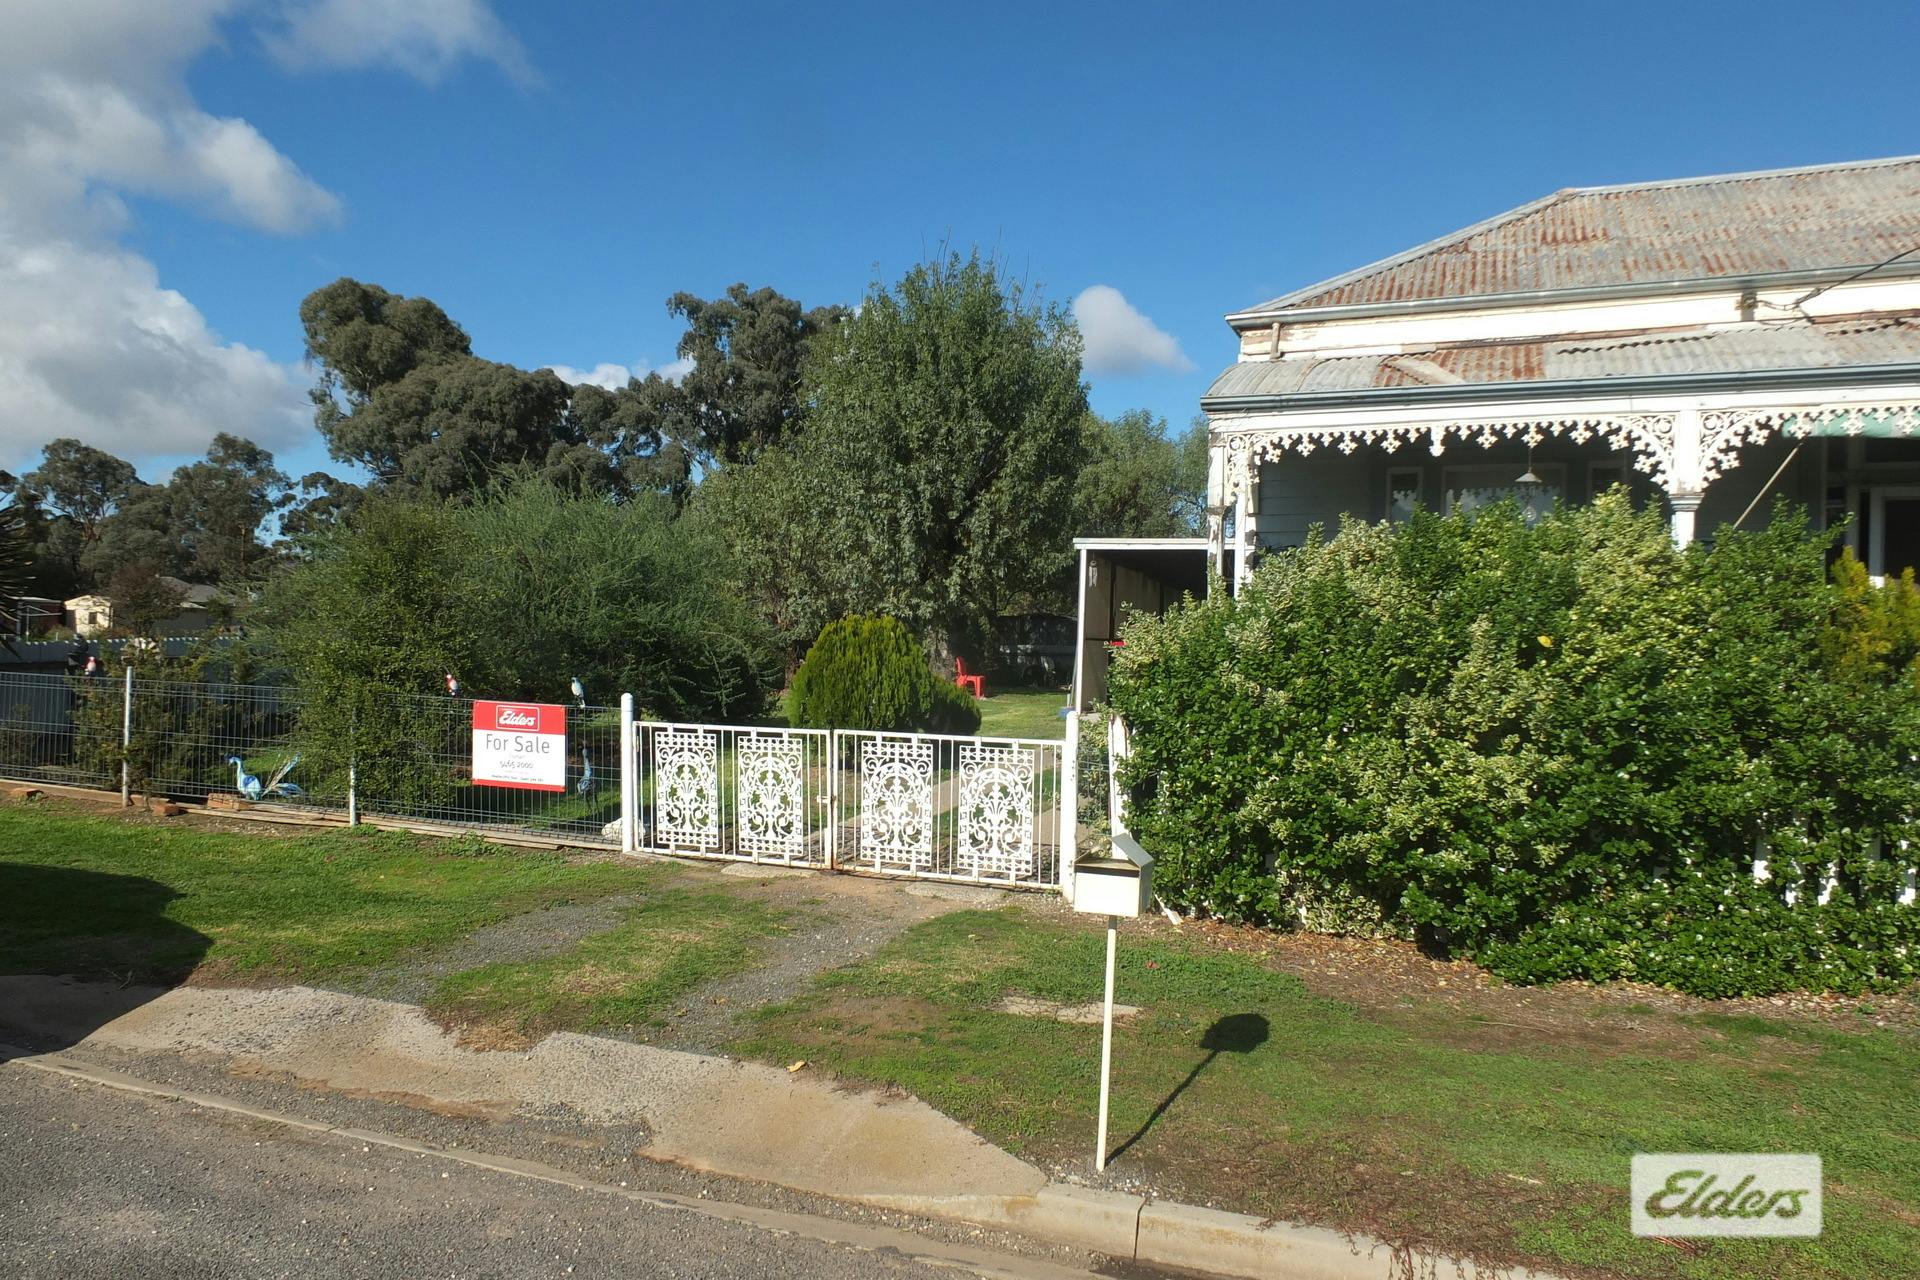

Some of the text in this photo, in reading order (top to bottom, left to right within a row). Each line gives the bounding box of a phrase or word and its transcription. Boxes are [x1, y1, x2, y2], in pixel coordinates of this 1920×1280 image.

[499, 710, 536, 726] Elders
[486, 733, 550, 753] For Sale
